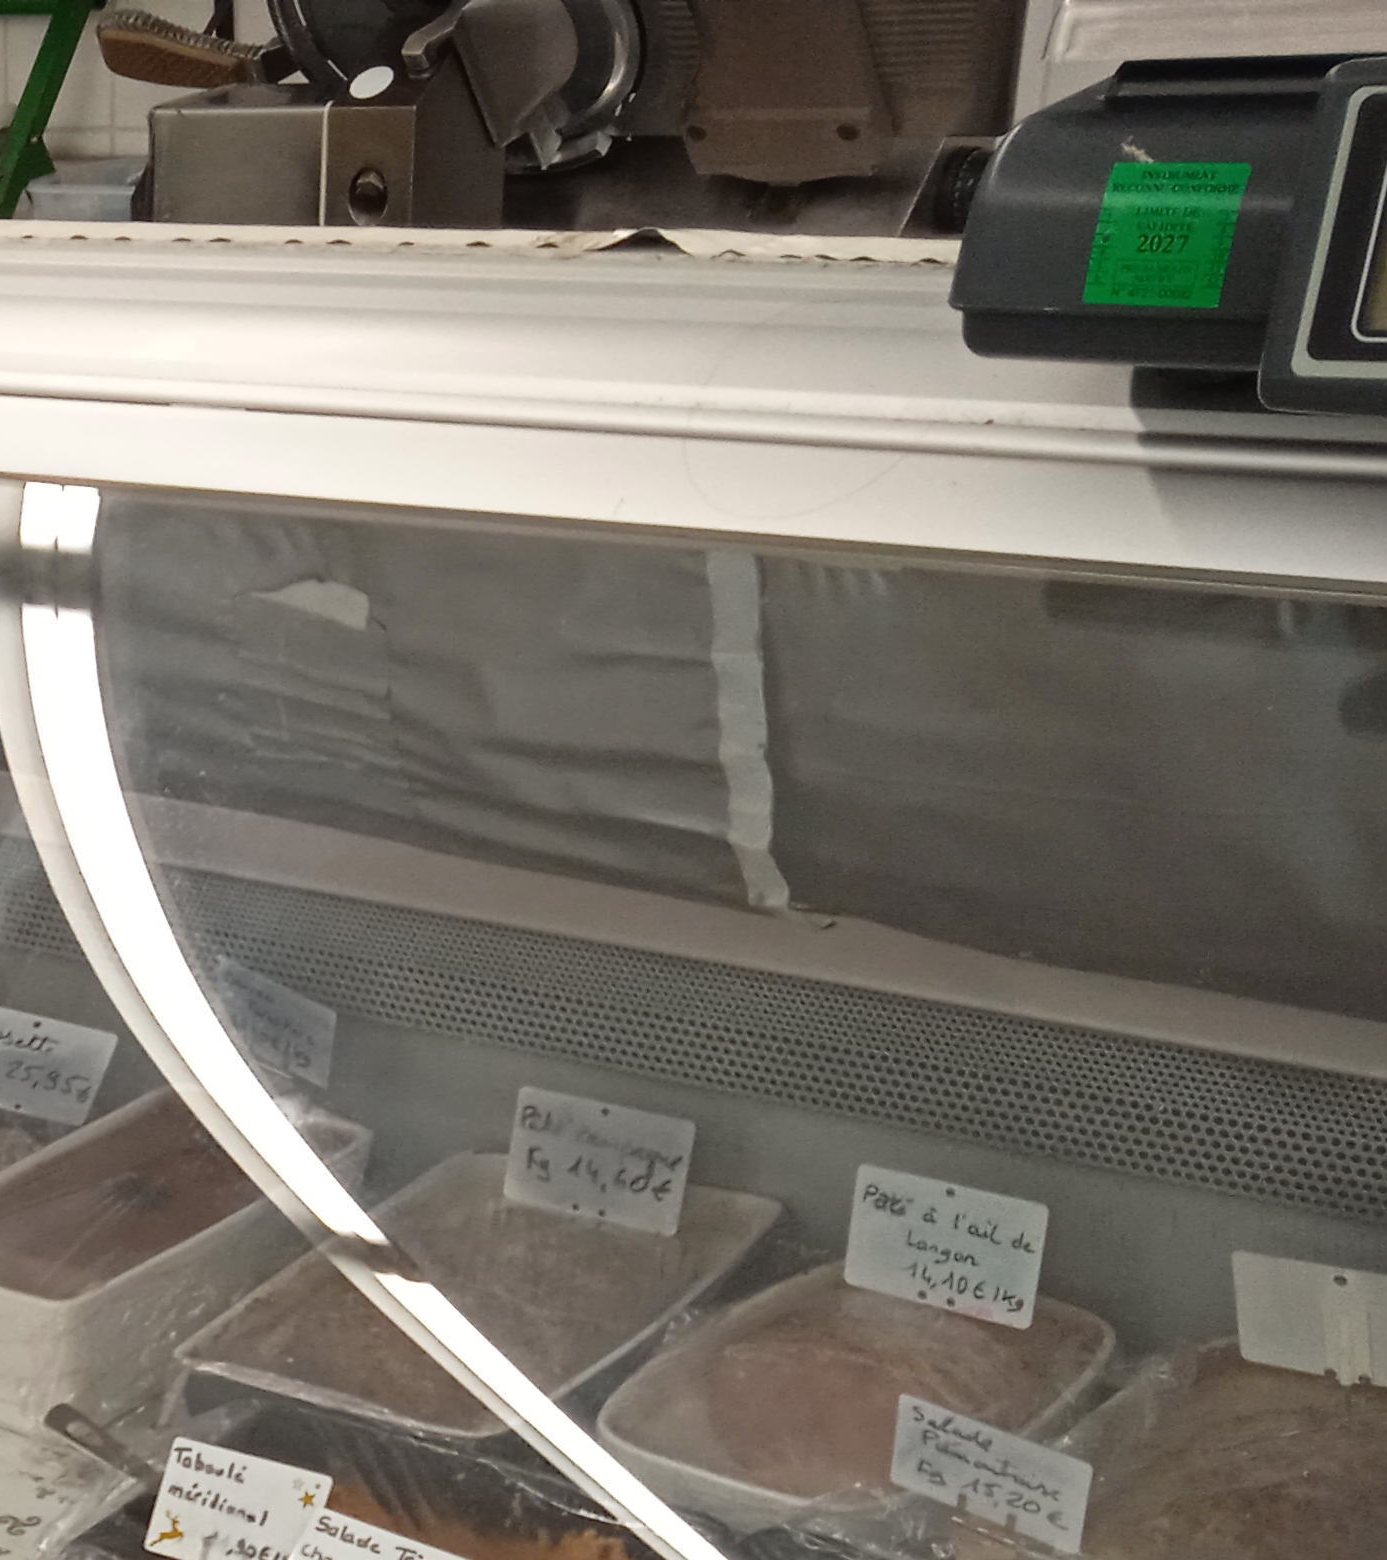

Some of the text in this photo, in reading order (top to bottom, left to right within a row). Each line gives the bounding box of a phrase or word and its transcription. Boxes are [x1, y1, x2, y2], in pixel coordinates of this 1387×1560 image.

[1135, 234, 1190, 253] 2027
[907, 1229, 981, 1268] Langon
[1011, 1232, 1038, 1254] de
[174, 1447, 248, 1485] Taboulé
[168, 1482, 269, 1527] méridional
[315, 1515, 381, 1555] Salade
